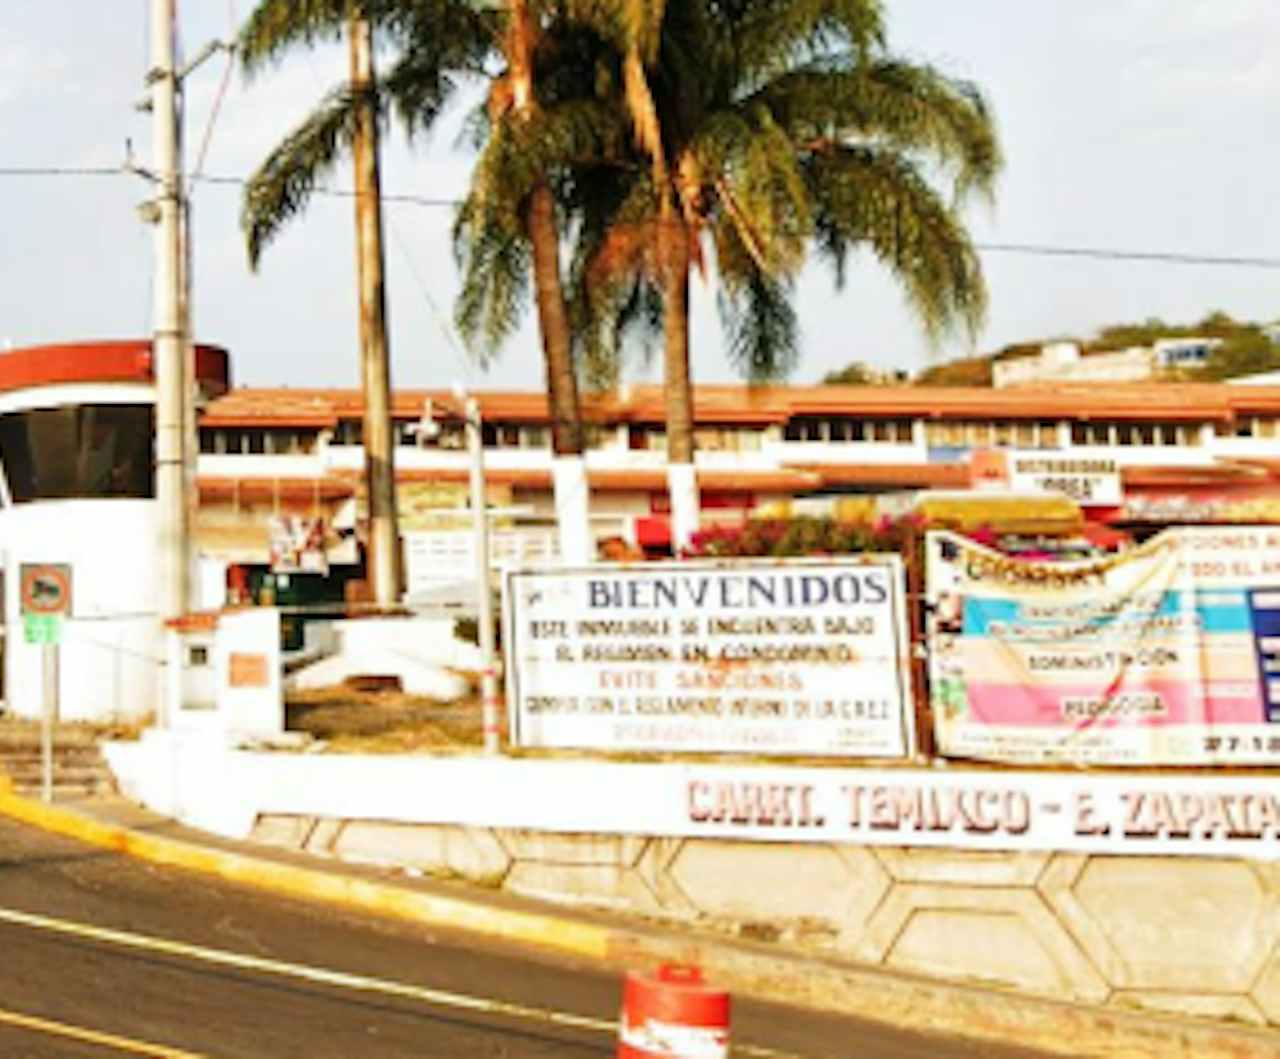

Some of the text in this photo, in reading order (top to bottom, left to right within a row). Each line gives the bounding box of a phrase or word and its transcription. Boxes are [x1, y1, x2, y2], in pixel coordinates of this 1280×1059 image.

[587, 573, 888, 609] BIENVENIDOS
[529, 619, 569, 639] ESTE
[707, 615, 816, 636] ENCUENTRA
[823, 616, 875, 636] BAJO
[841, 784, 1032, 836] TEMIXCO
[1074, 793, 1111, 837] E.
[1120, 793, 1280, 841] ZAPATA
